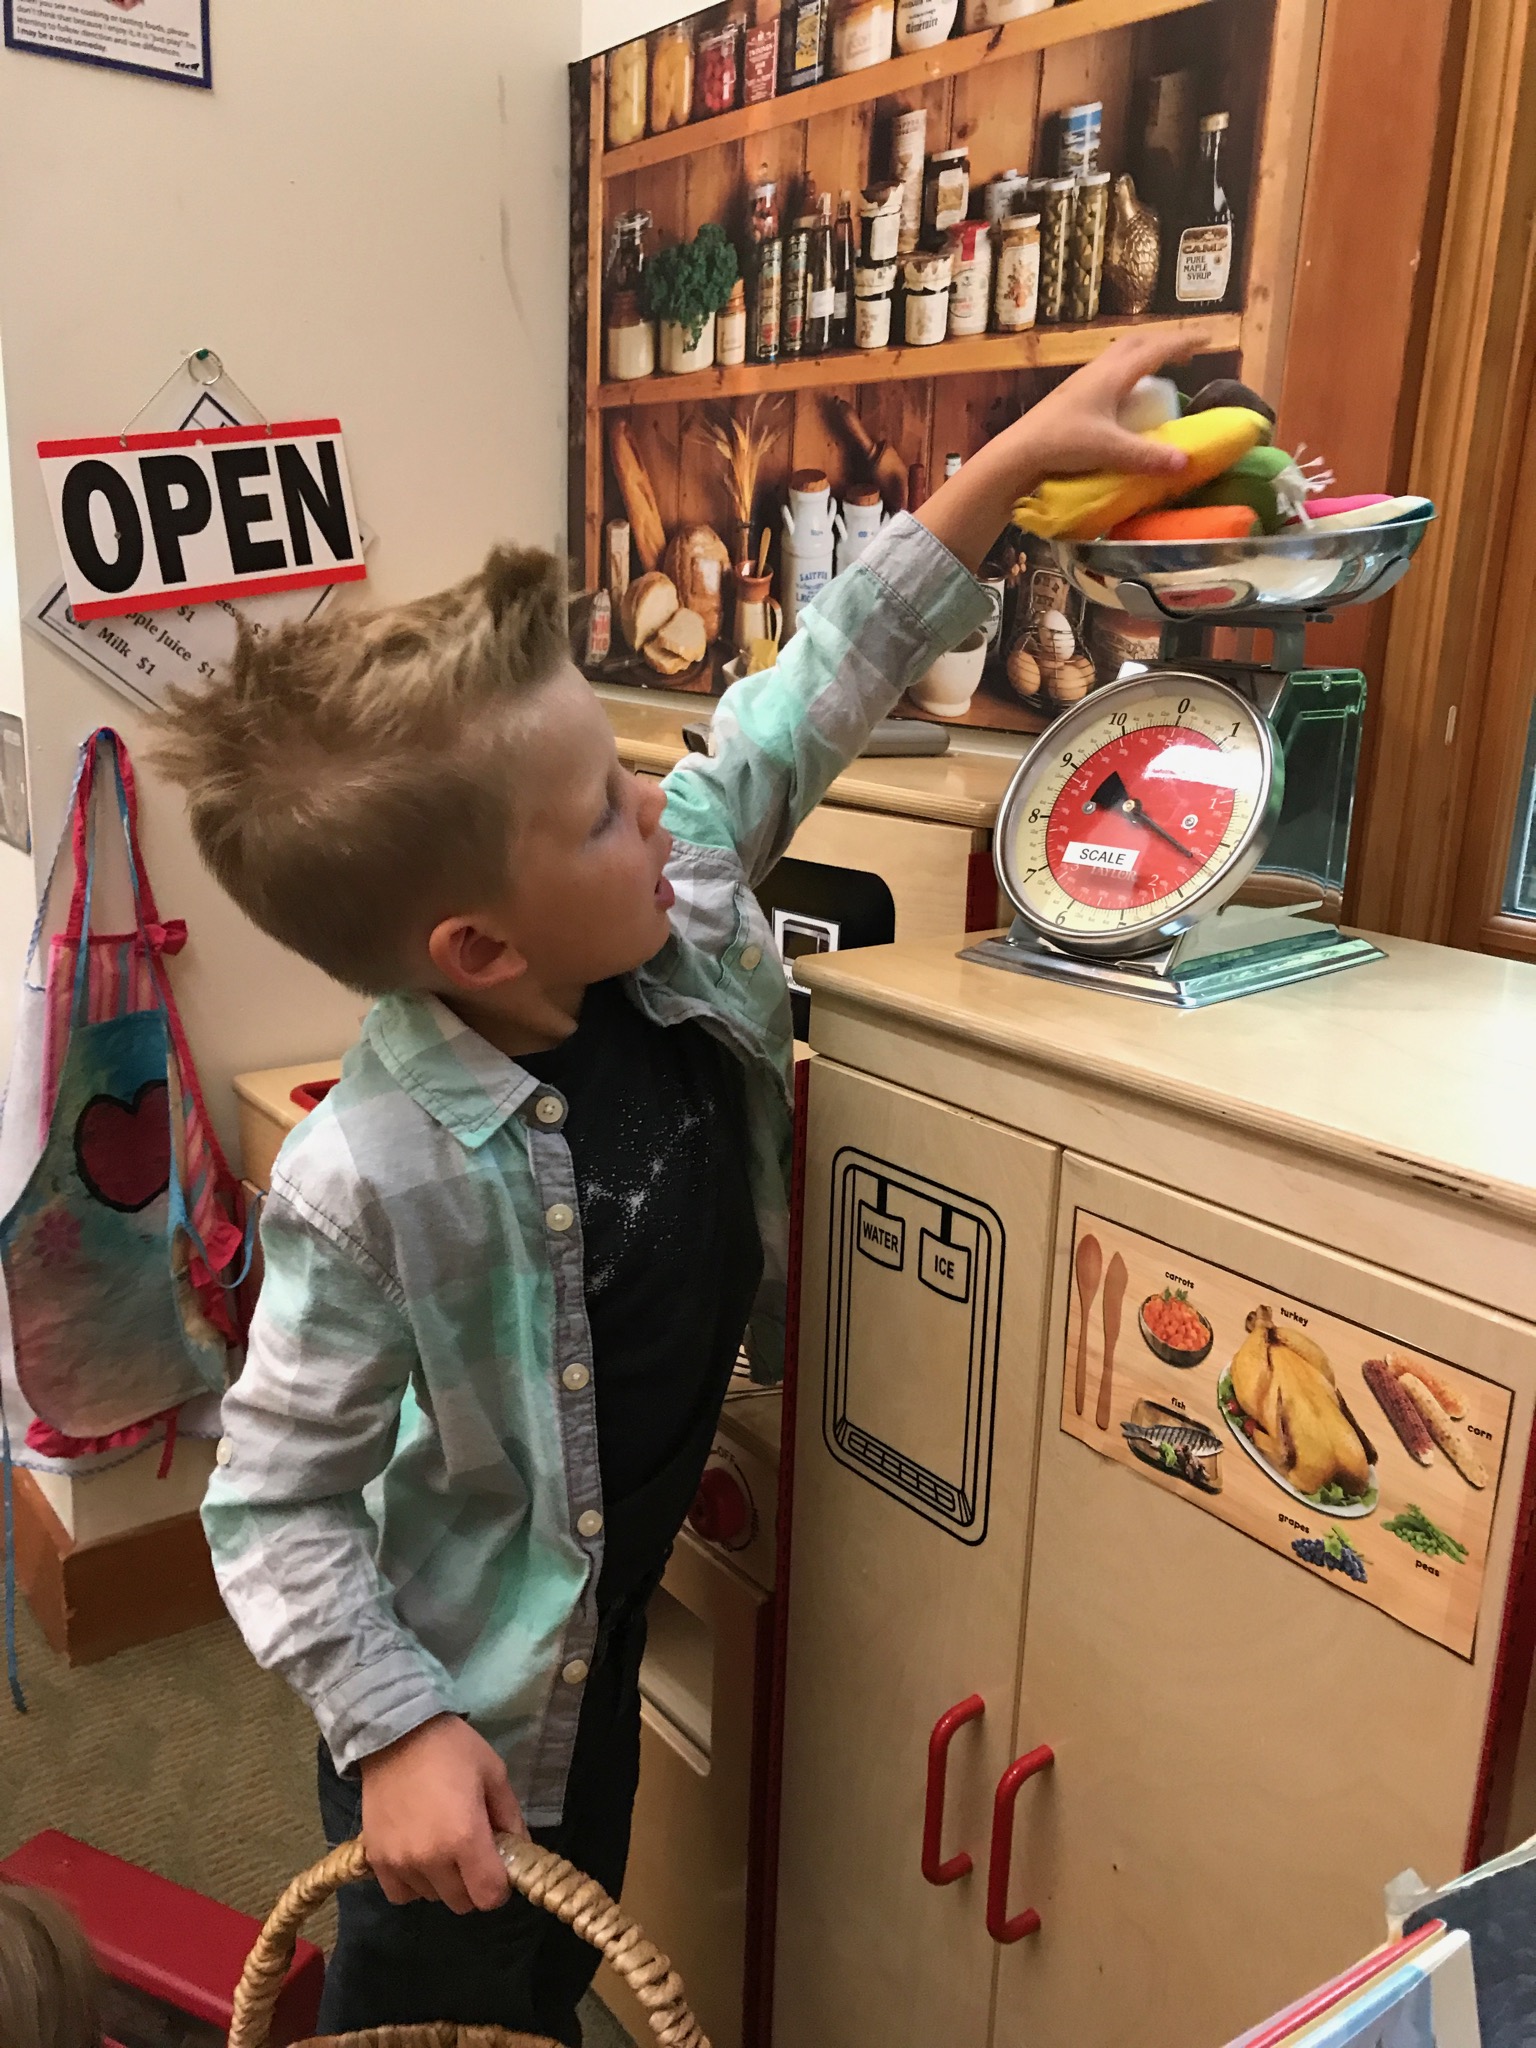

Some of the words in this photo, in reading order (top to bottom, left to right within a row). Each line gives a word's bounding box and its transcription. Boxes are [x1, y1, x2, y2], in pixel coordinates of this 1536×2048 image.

[1183, 264, 1208, 272] MAPLE
[1186, 255, 1206, 264] PURE
[1187, 272, 1212, 280] SYRUP
[62, 440, 354, 594] OPEN
[177, 605, 195, 624] $1
[97, 627, 131, 658] Milk
[136, 656, 156, 676] $1
[124, 612, 159, 635] pple
[156, 629, 192, 661] Juice
[197, 661, 216, 679] $1
[1177, 698, 1191, 714] 0
[1108, 712, 1128, 726] 10
[1228, 721, 1241, 738] 1
[1060, 752, 1073, 768] 9
[1079, 779, 1089, 791] 4
[1208, 798, 1218, 810] 1
[1028, 808, 1041, 824] 8
[1079, 848, 1126, 866] SCALE
[1023, 867, 1037, 884] 7
[1147, 873, 1160, 887] 2
[1054, 910, 1068, 926] 6
[862, 1220, 899, 1254] WATER
[934, 1254, 955, 1280] ICE
[1164, 1270, 1195, 1290] carrots
[1280, 1307, 1309, 1327] turkey
[1171, 1397, 1186, 1410] fish
[1466, 1424, 1493, 1441] corn
[1278, 1512, 1310, 1534] grapes
[1415, 1559, 1440, 1577] peas
